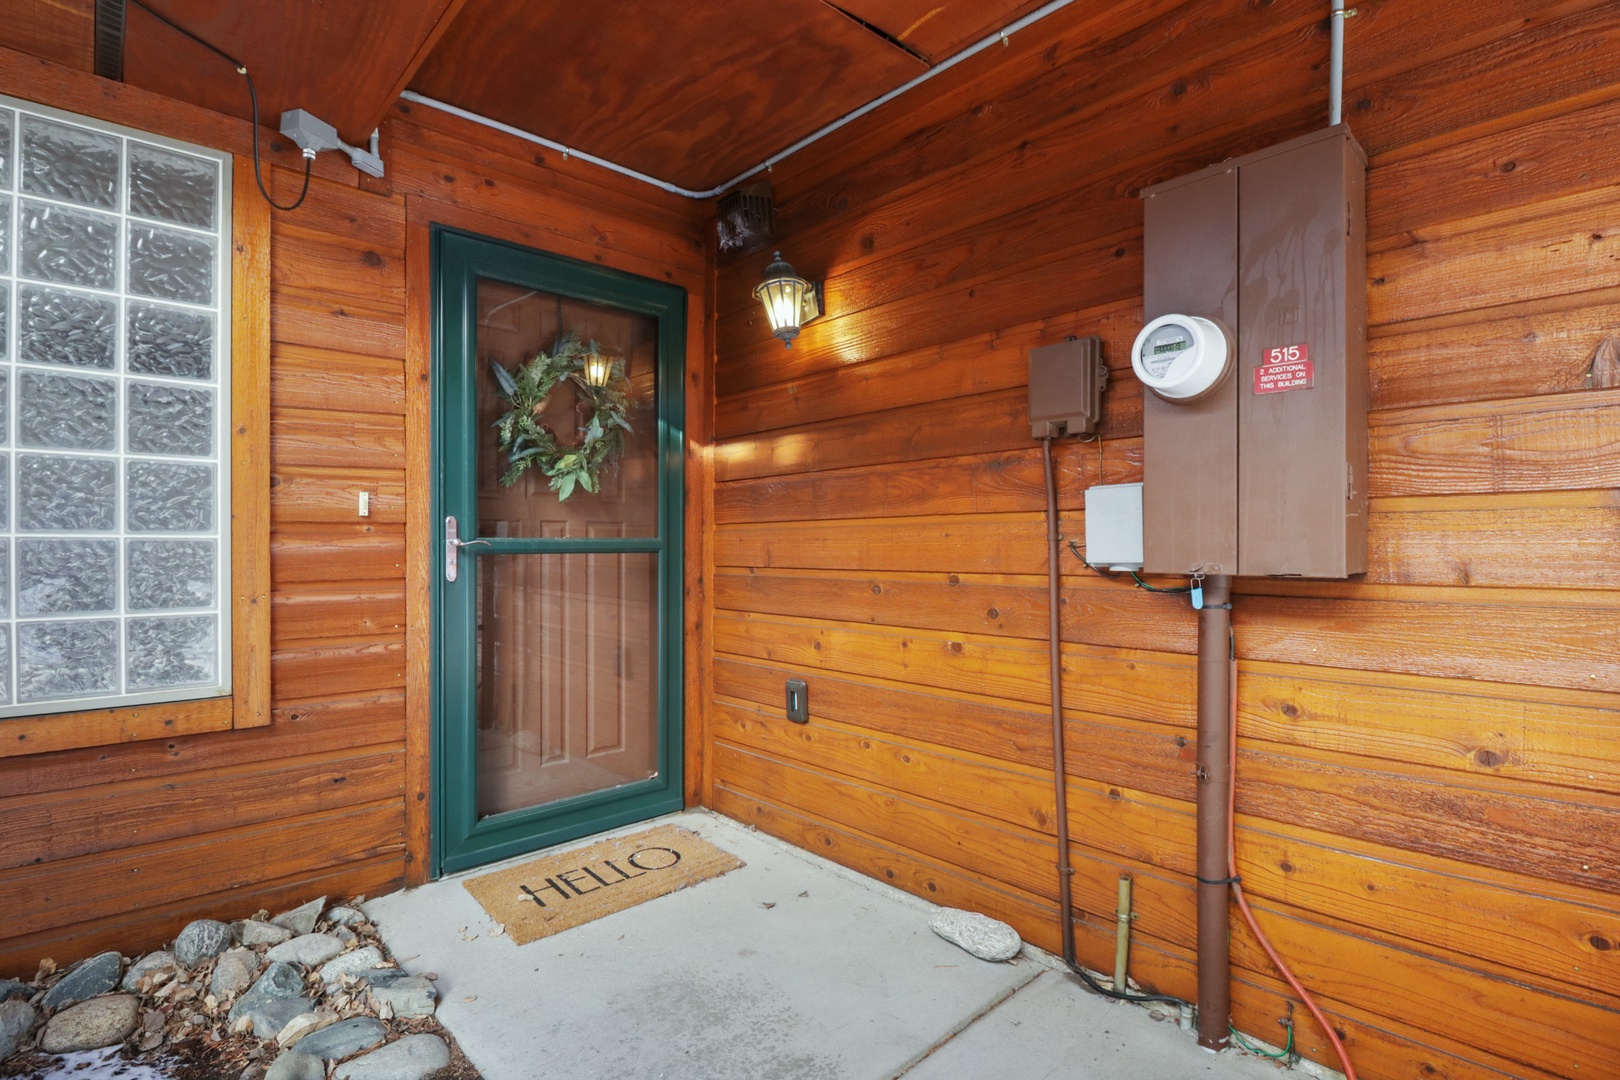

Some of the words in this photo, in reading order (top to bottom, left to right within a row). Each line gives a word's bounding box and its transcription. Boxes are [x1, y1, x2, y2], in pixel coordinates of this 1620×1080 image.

[1270, 345, 1300, 363] 515
[1268, 364, 1306, 374] ADDITIONAL
[1260, 372, 1292, 382] SERVICES
[1277, 378, 1307, 388] BUILDING
[519, 847, 682, 908] HELLO
